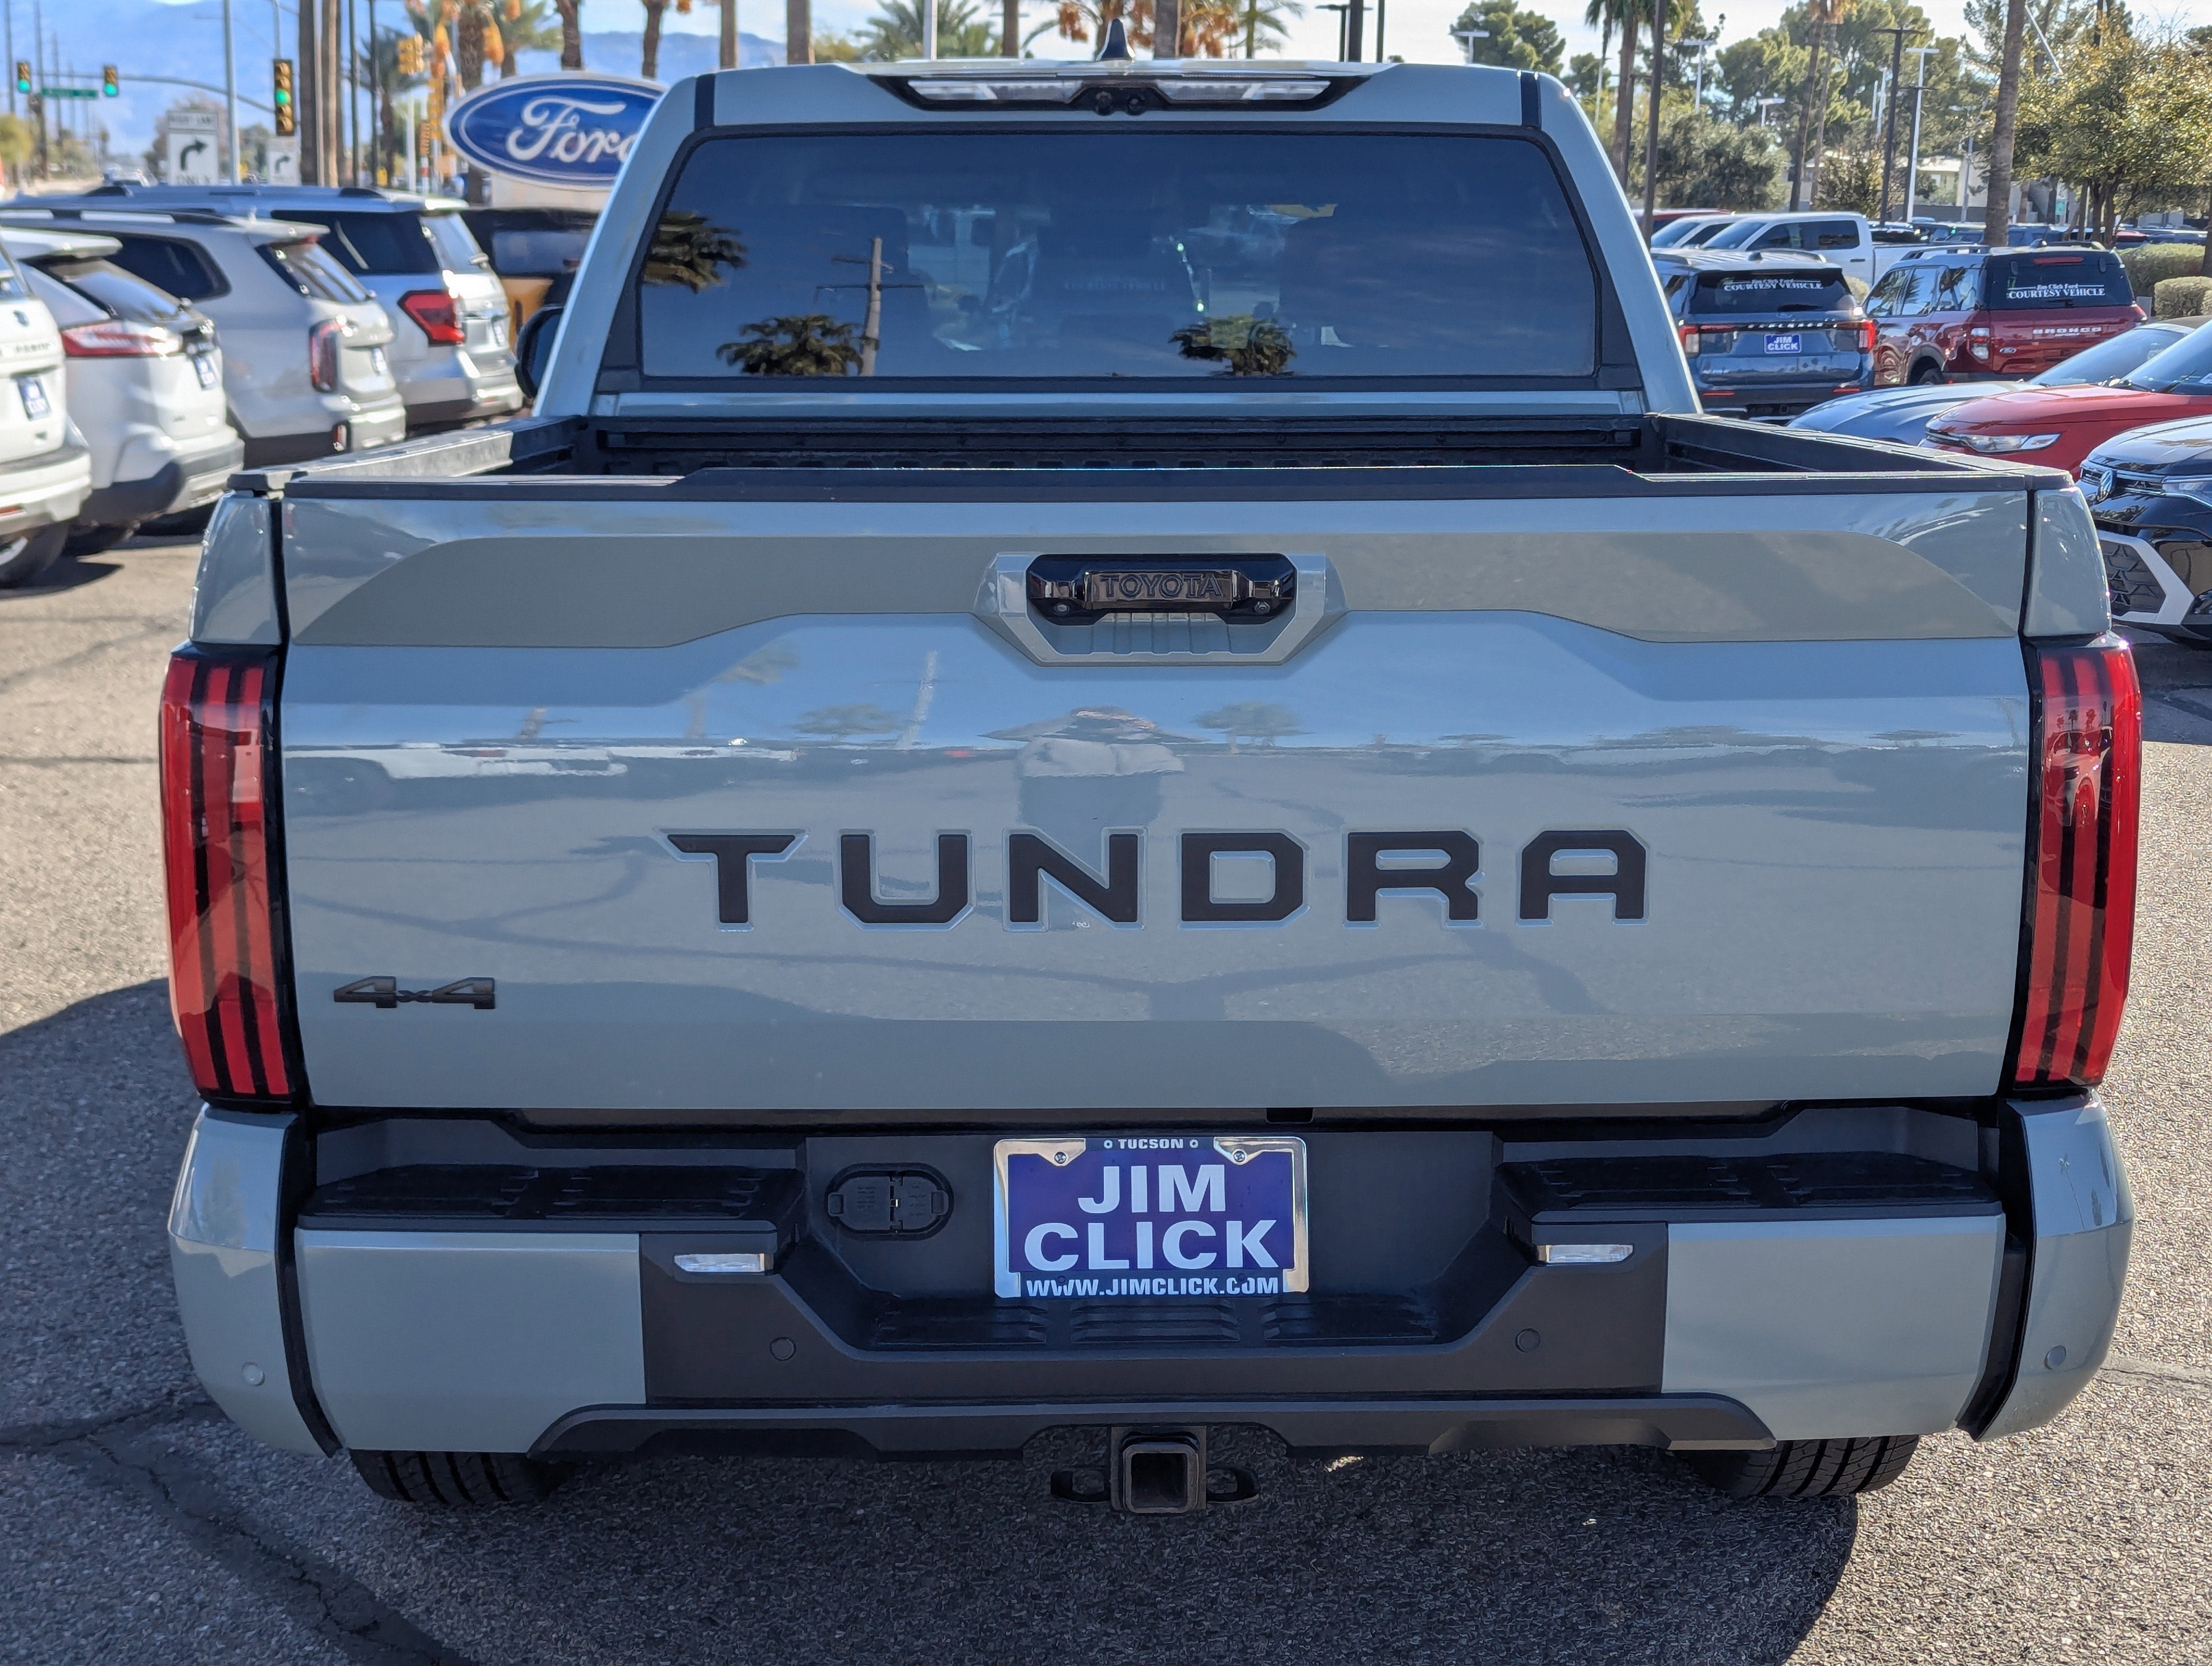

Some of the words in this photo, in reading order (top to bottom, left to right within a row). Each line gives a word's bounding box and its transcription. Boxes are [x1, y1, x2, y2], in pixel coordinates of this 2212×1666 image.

[1724, 283, 1777, 291] COURTESY
[2008, 289, 2061, 299] COURTESY
[2063, 288, 2106, 297] VEHICLE
[1767, 343, 1798, 351] CLICK
[1773, 336, 1793, 344] JIM
[1100, 573, 1222, 598] TOYOTA
[666, 830, 1647, 924] TUNDRA
[1118, 1138, 1184, 1149] TUCSON
[1078, 1164, 1226, 1214] JIM
[1024, 1219, 1279, 1271] CLICK
[1026, 1277, 1279, 1297] WWW.JIMCLICK.COM
